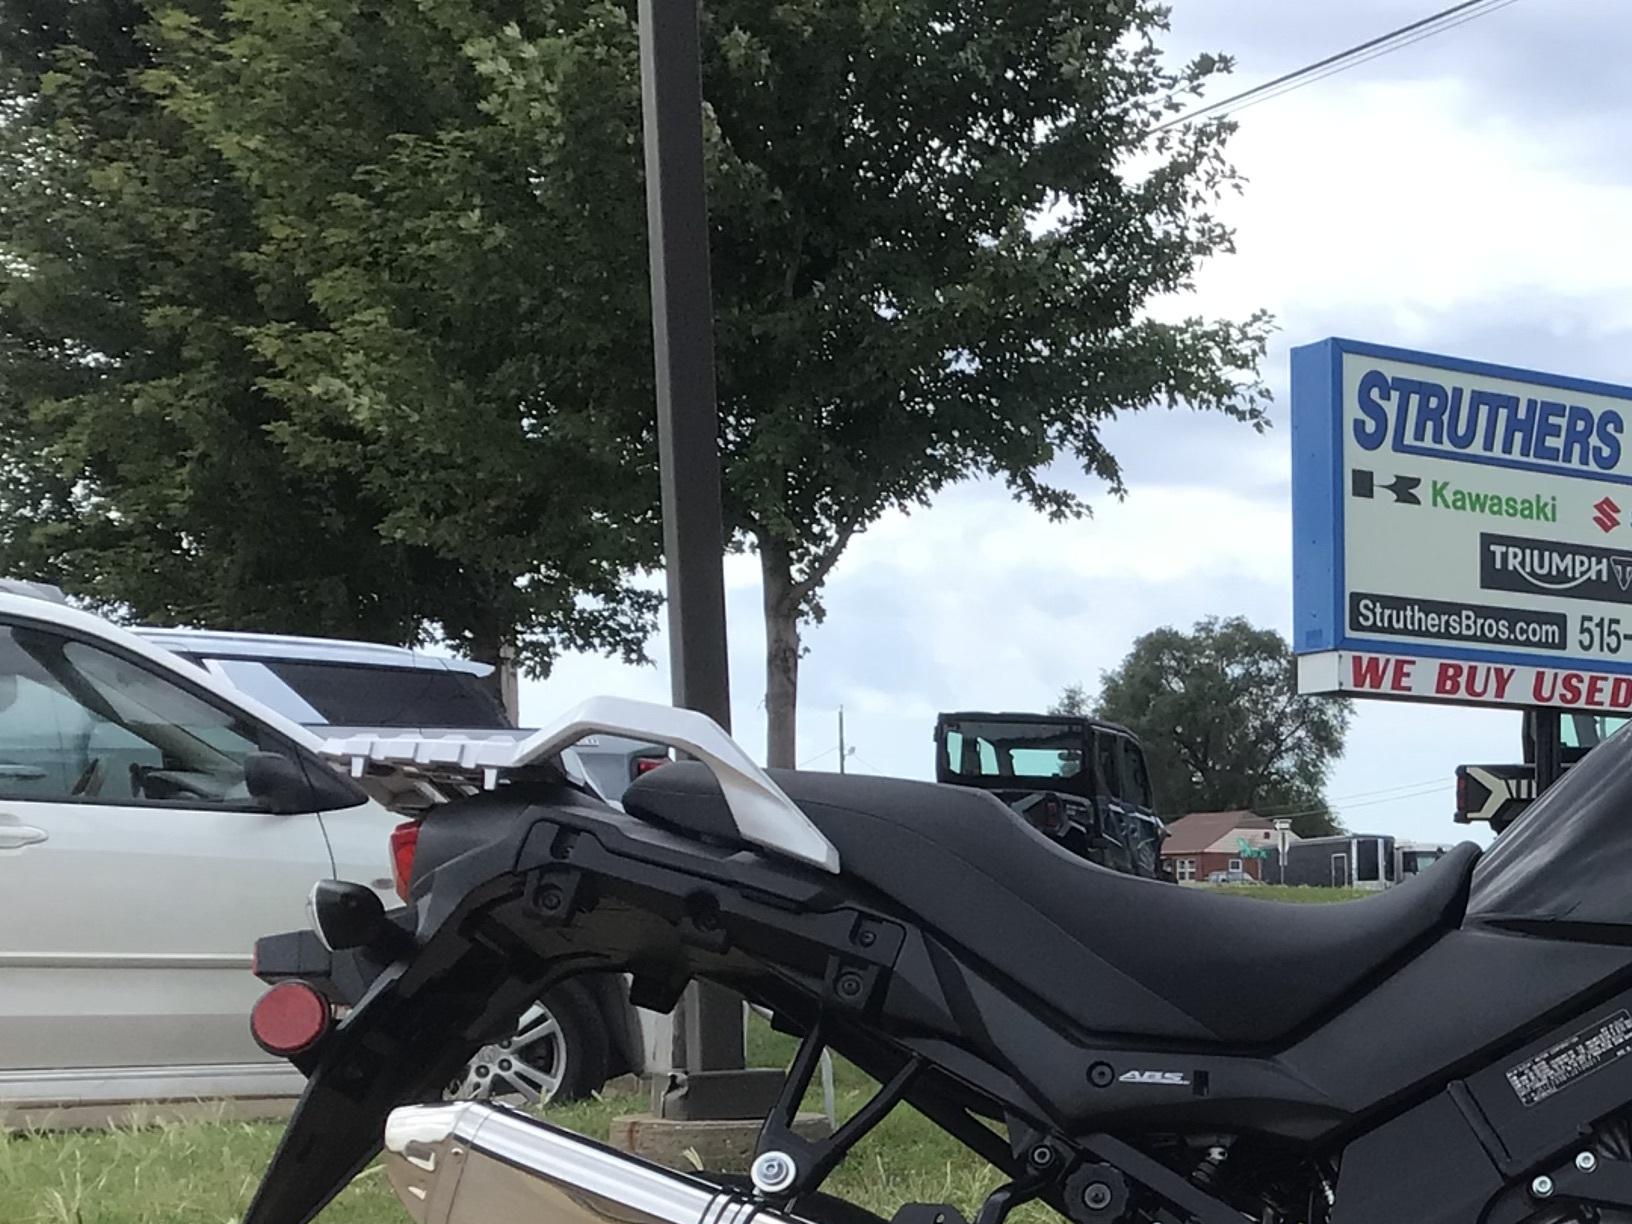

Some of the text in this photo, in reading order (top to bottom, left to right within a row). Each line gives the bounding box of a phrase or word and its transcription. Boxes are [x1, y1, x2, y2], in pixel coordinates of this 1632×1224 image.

[1353, 370, 1624, 470] STRUTHERS
[1431, 480, 1557, 522] Kawasaki
[1490, 545, 1608, 588] TRIUMPH
[1358, 600, 1559, 644] StruthersBros.com
[1352, 655, 1416, 692] WE
[1435, 662, 1515, 699] BUY
